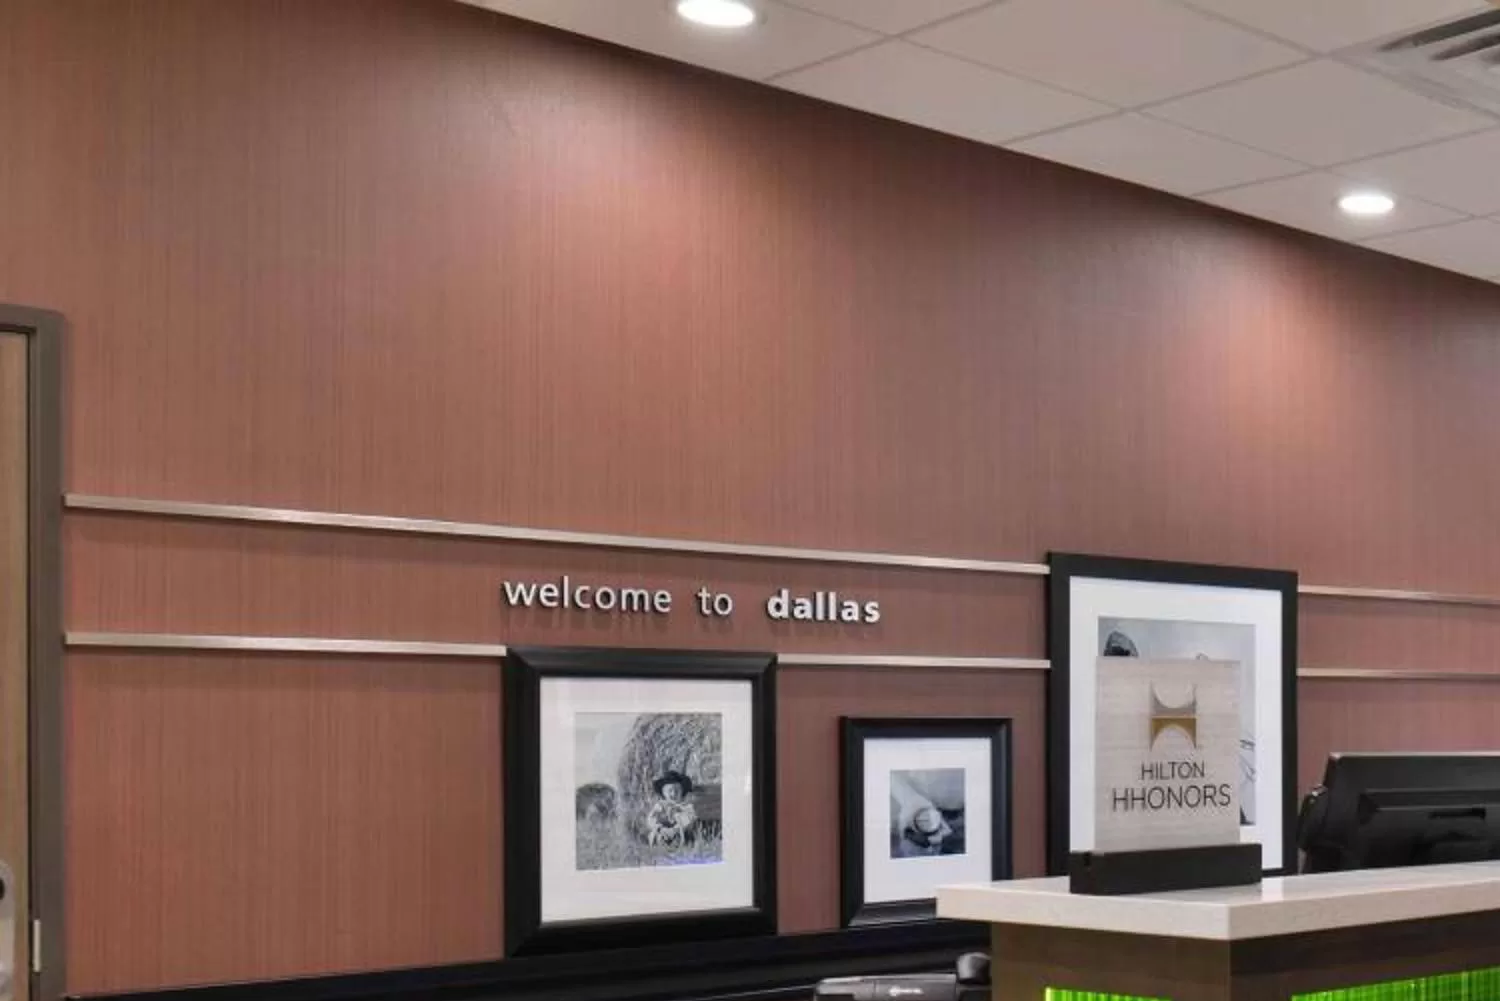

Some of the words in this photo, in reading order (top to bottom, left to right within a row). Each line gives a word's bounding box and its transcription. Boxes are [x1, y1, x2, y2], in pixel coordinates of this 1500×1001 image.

[503, 576, 672, 613] welcome
[698, 586, 733, 616] to
[767, 588, 881, 624] dallas
[1140, 761, 1206, 781] HILTON
[1112, 784, 1232, 812] HHONORS
